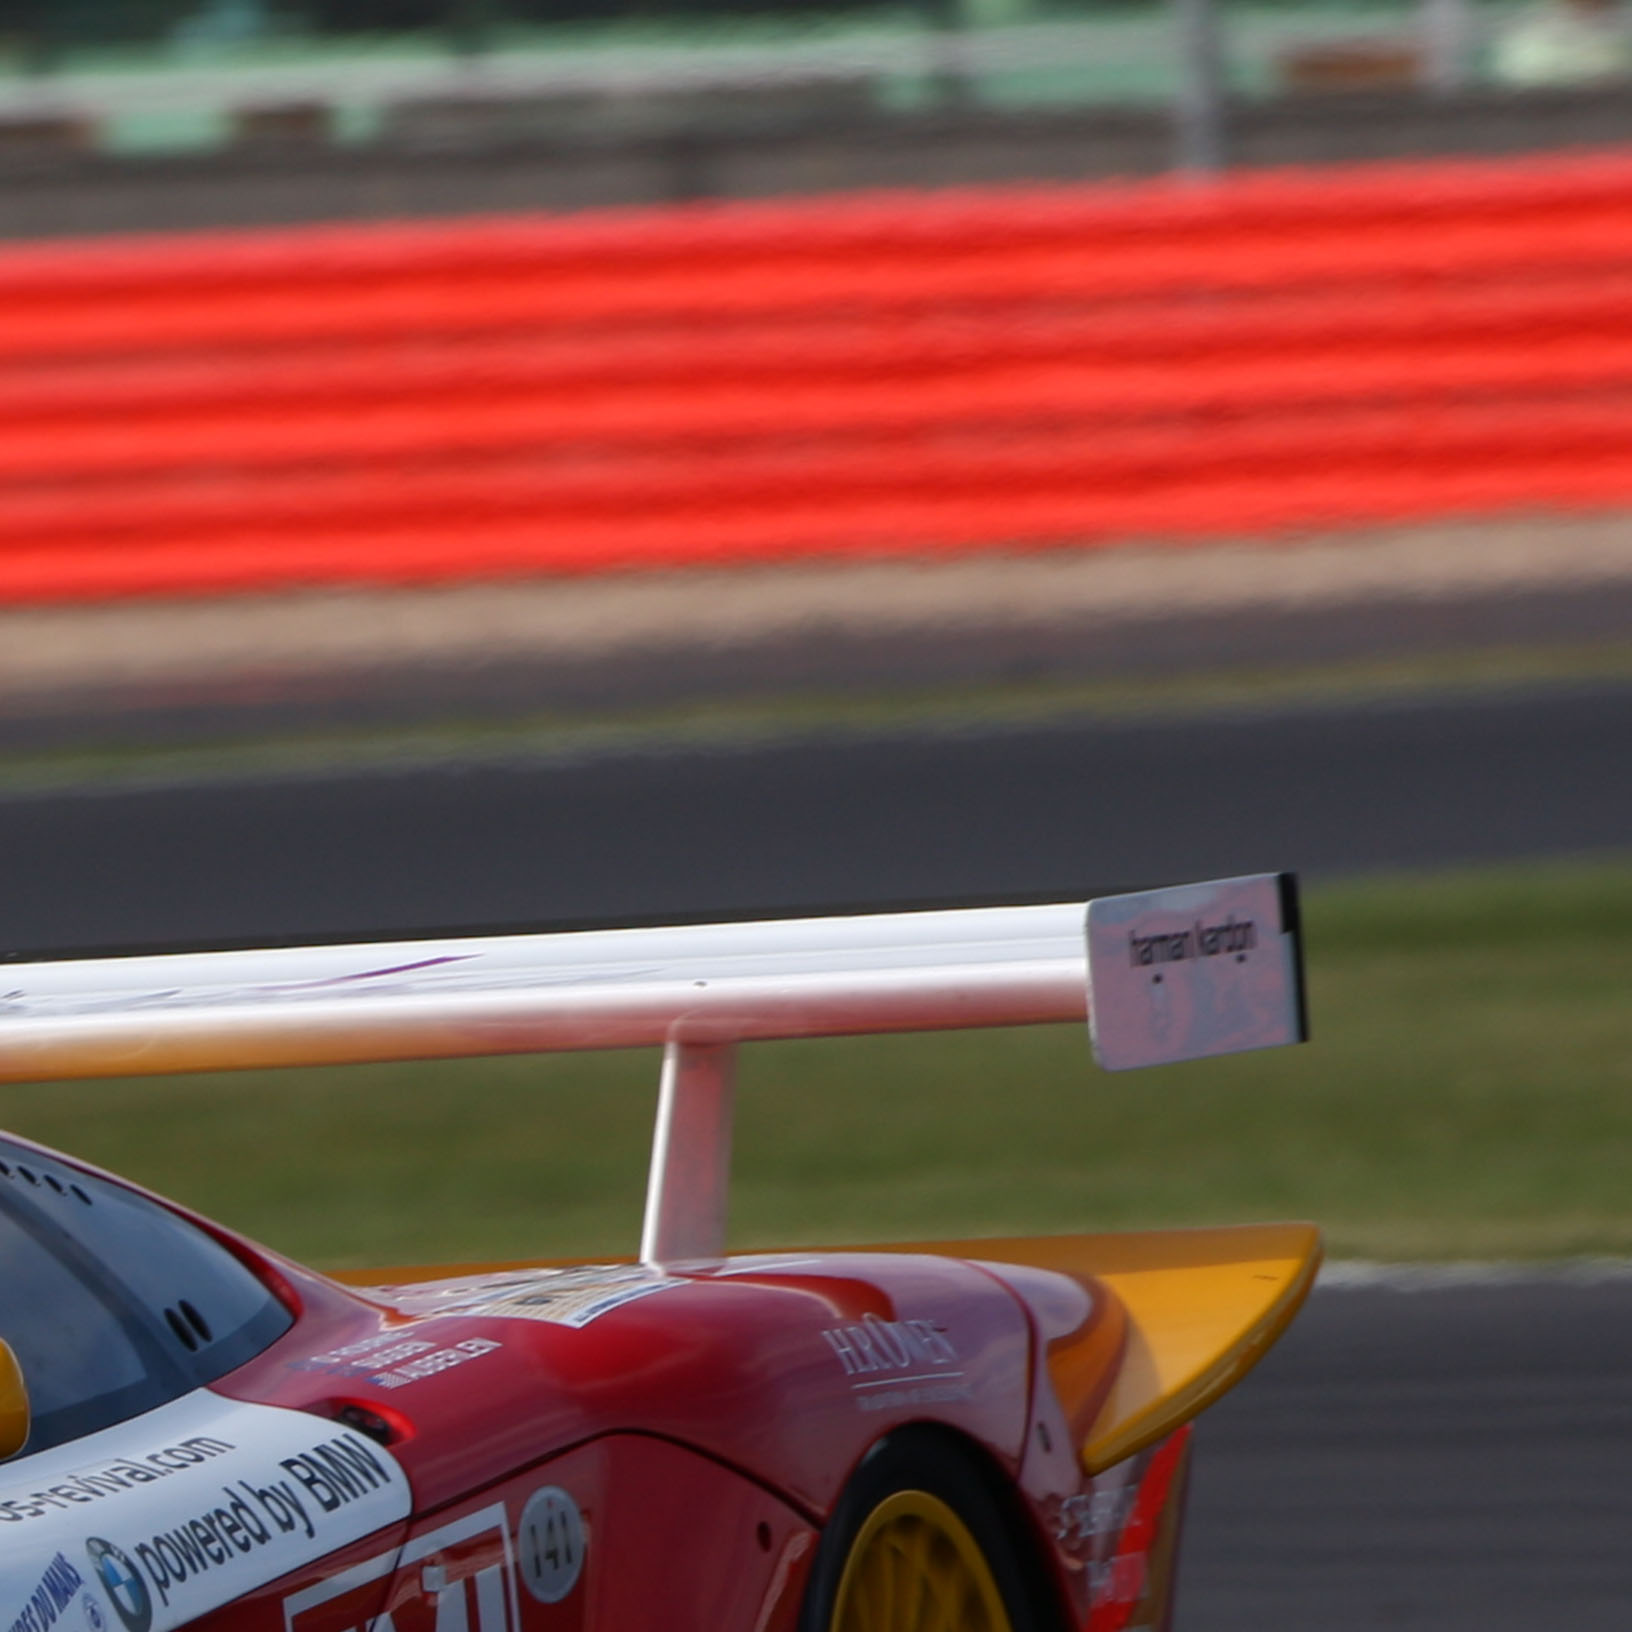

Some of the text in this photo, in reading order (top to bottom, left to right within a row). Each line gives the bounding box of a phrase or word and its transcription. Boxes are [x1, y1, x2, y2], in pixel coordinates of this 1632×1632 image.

[136, 1433, 392, 1606] powered by BMW
[531, 1510, 572, 1578] 141
[42, 1552, 84, 1614] MANS
